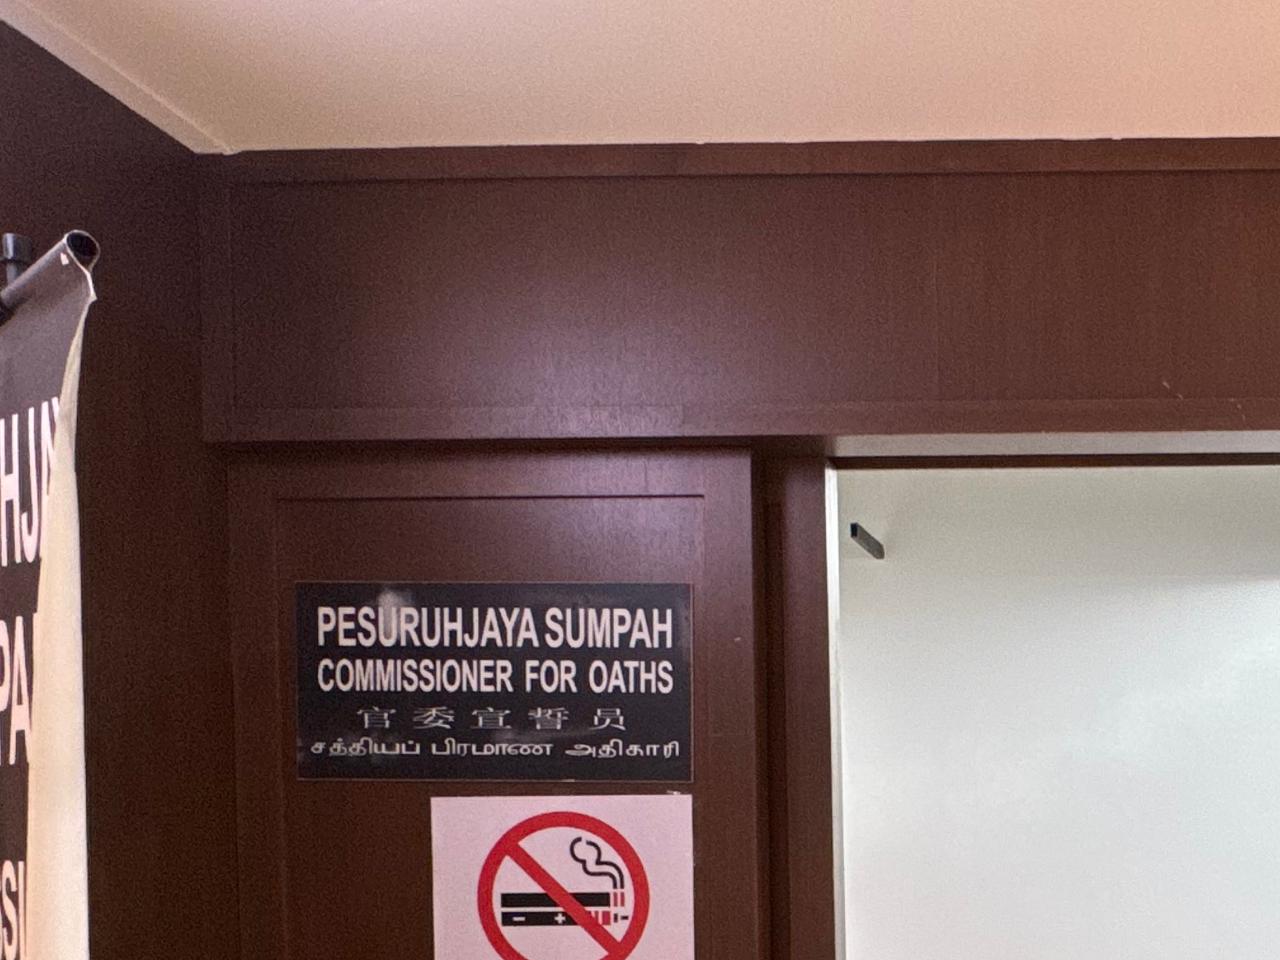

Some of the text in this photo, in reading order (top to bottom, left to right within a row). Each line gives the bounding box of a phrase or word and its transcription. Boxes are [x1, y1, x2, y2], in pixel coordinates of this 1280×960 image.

[317, 606, 673, 649] PESURUHJAYA SUMPAH
[317, 658, 674, 694] COMMISSIONER FOR OATHS
[356, 706, 626, 731] 官委宣誓员
